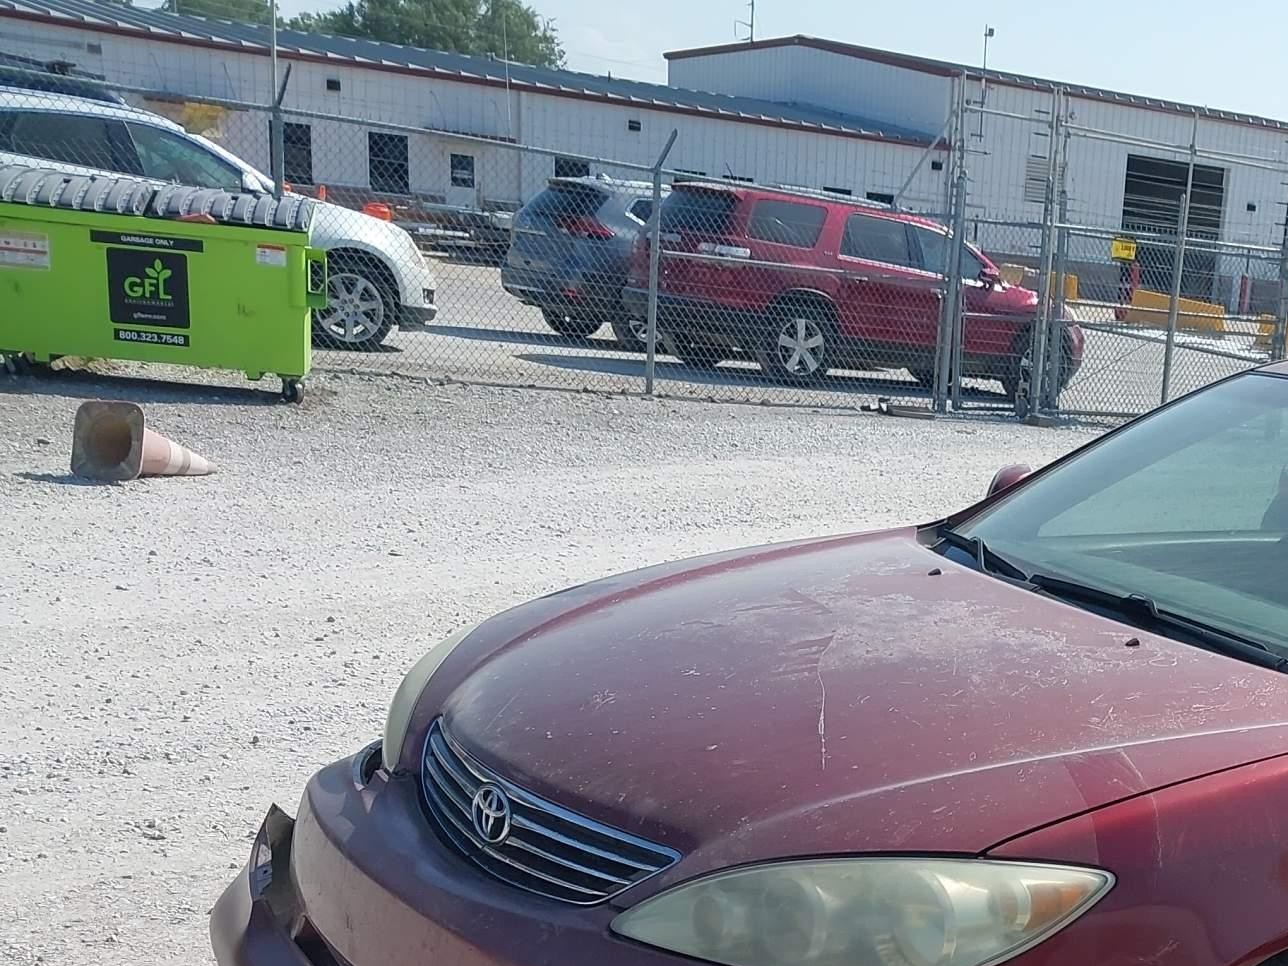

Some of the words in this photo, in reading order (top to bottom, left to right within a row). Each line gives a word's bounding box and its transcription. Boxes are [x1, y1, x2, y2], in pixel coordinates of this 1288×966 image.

[121, 235, 154, 245] GARBAGE
[155, 239, 174, 247] ONLY
[124, 268, 172, 300] GFL
[119, 330, 185, 345] 800.323.7548
